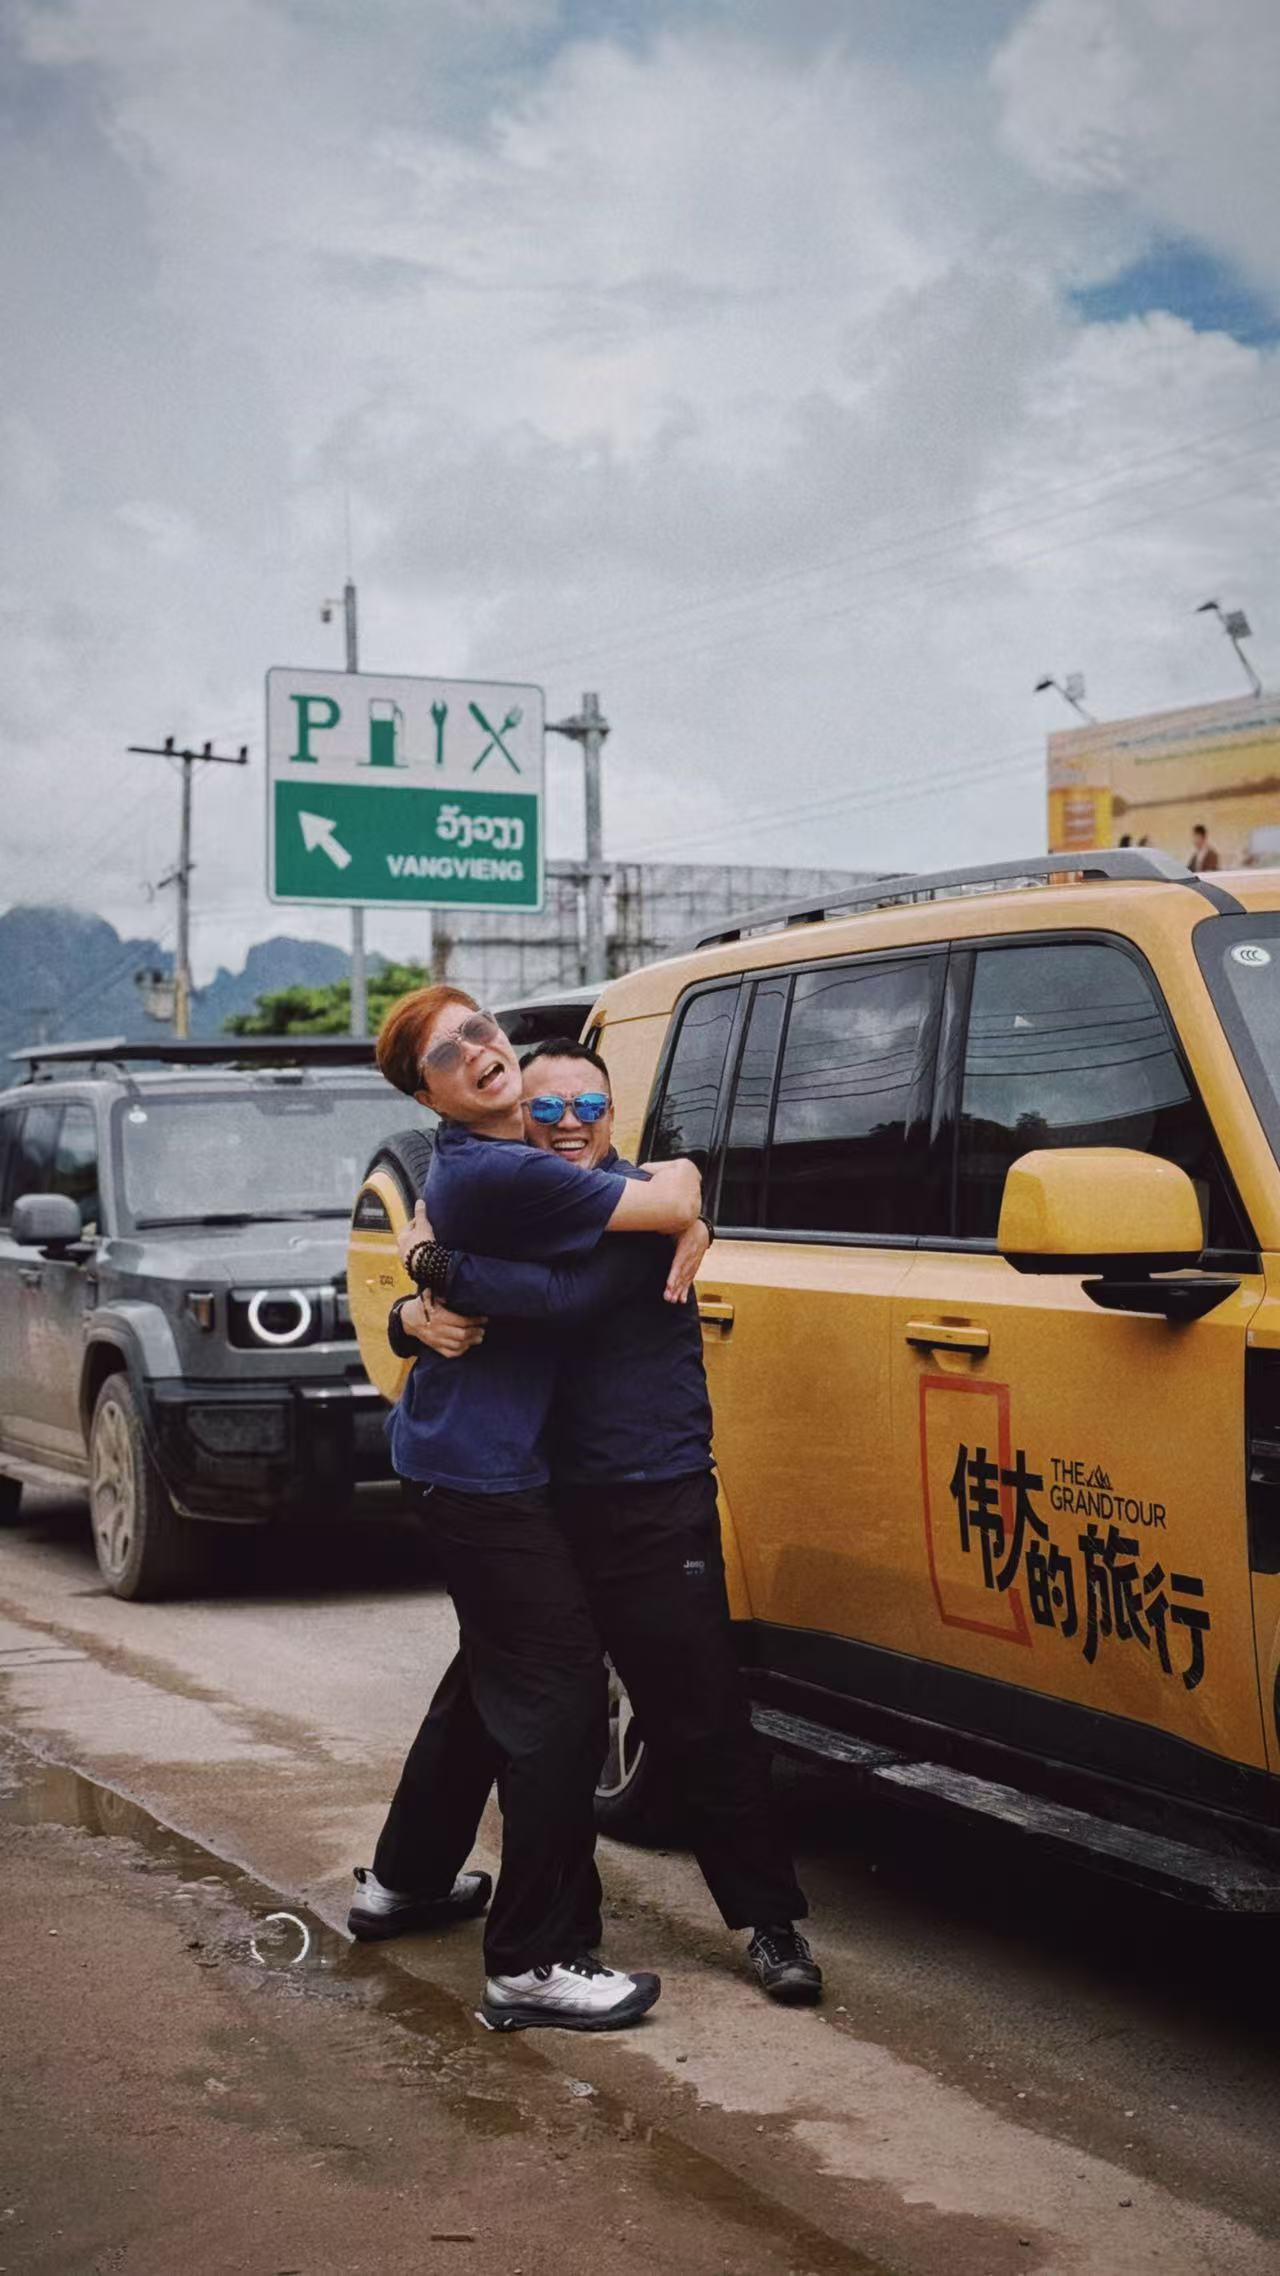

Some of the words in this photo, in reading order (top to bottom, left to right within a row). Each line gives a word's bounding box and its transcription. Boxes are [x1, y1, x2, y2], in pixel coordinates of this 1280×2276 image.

[289, 694, 341, 764] P
[386, 854, 525, 881] VANGVIENG
[1050, 1458, 1085, 1486] THE
